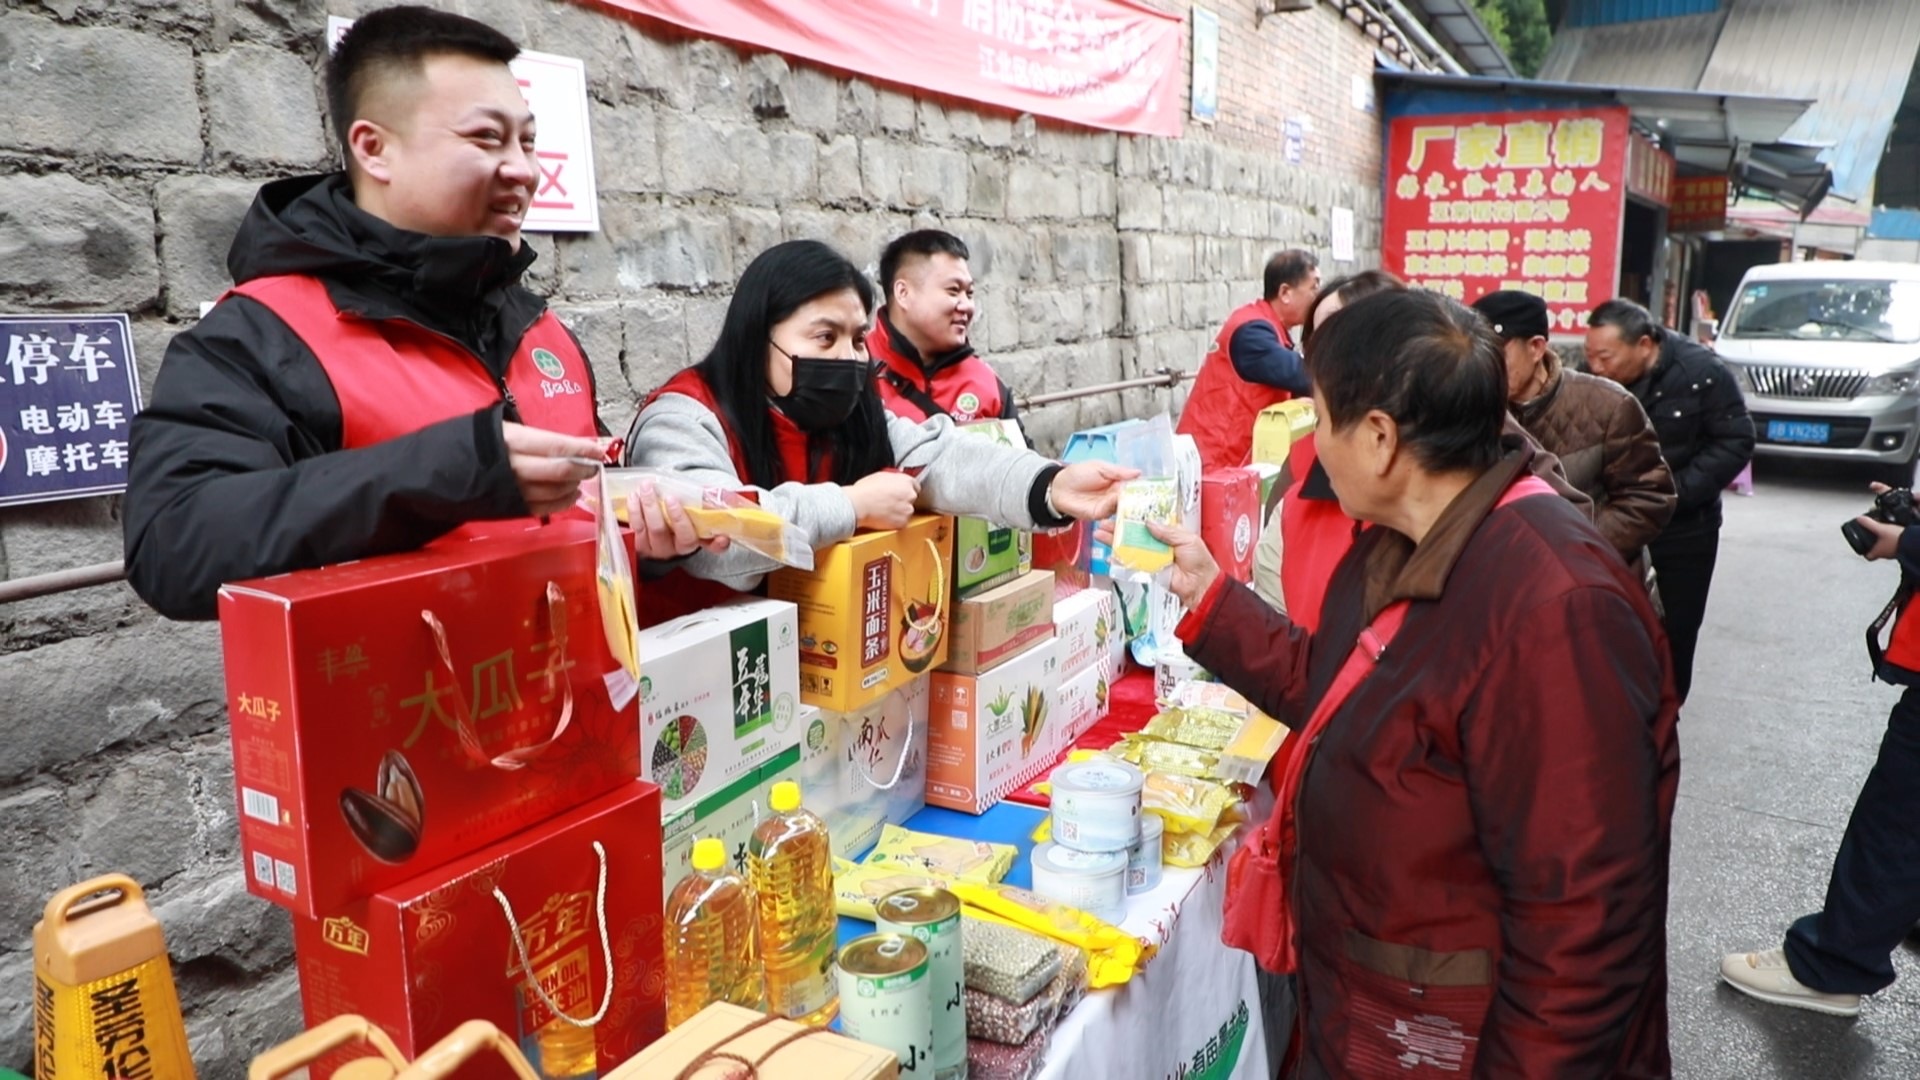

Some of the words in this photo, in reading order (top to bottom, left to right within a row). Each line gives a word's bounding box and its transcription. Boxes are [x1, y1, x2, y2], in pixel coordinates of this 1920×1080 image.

[1406, 117, 1604, 172] 厂家直销
[19, 400, 126, 435] 电动车
[25, 439, 128, 478] 摩托车
[864, 566, 882, 661] 玉米面条
[237, 690, 282, 724] 大瓜子
[398, 640, 577, 750] 大瓜子
[327, 922, 368, 953] 万年
[519, 900, 586, 957] 万年
[561, 959, 581, 982] OIL
[1191, 997, 1250, 1076] 有亩黑土地
